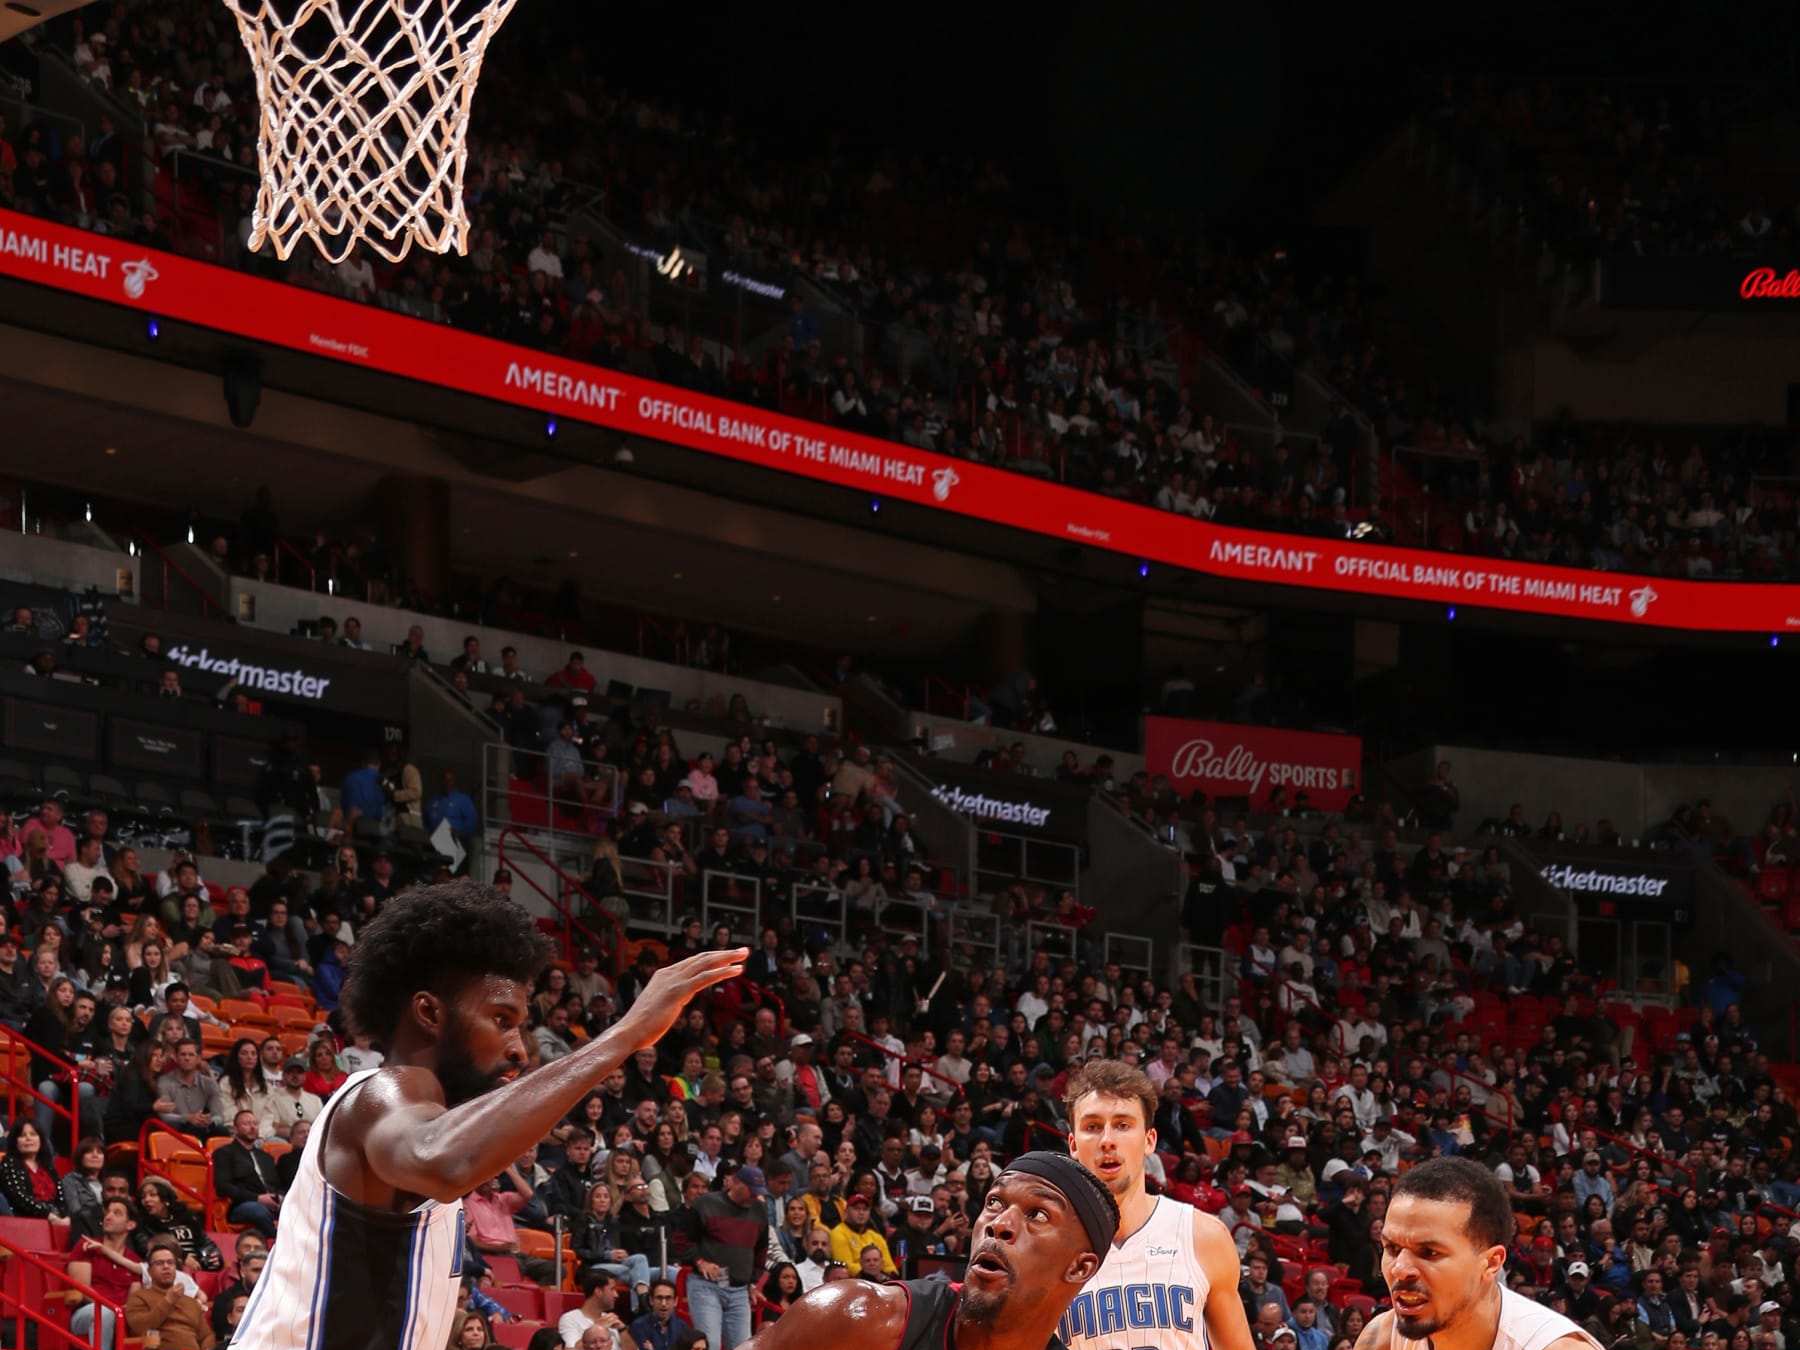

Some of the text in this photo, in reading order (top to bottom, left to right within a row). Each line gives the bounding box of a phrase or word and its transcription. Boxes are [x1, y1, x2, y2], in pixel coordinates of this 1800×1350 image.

[54, 244, 110, 279] HEAT
[505, 363, 925, 486] AMERANT OFFICIAL BANK OF THE MIAMI HEAT
[1210, 540, 1622, 606] AMERANT OFFICIAL BANK OF THE MIAMI HEAT
[1172, 739, 1267, 794] Bally
[1270, 763, 1337, 790] SPORTS
[1146, 1245, 1178, 1257] Disney
[1056, 1283, 1194, 1347] MAGIC
